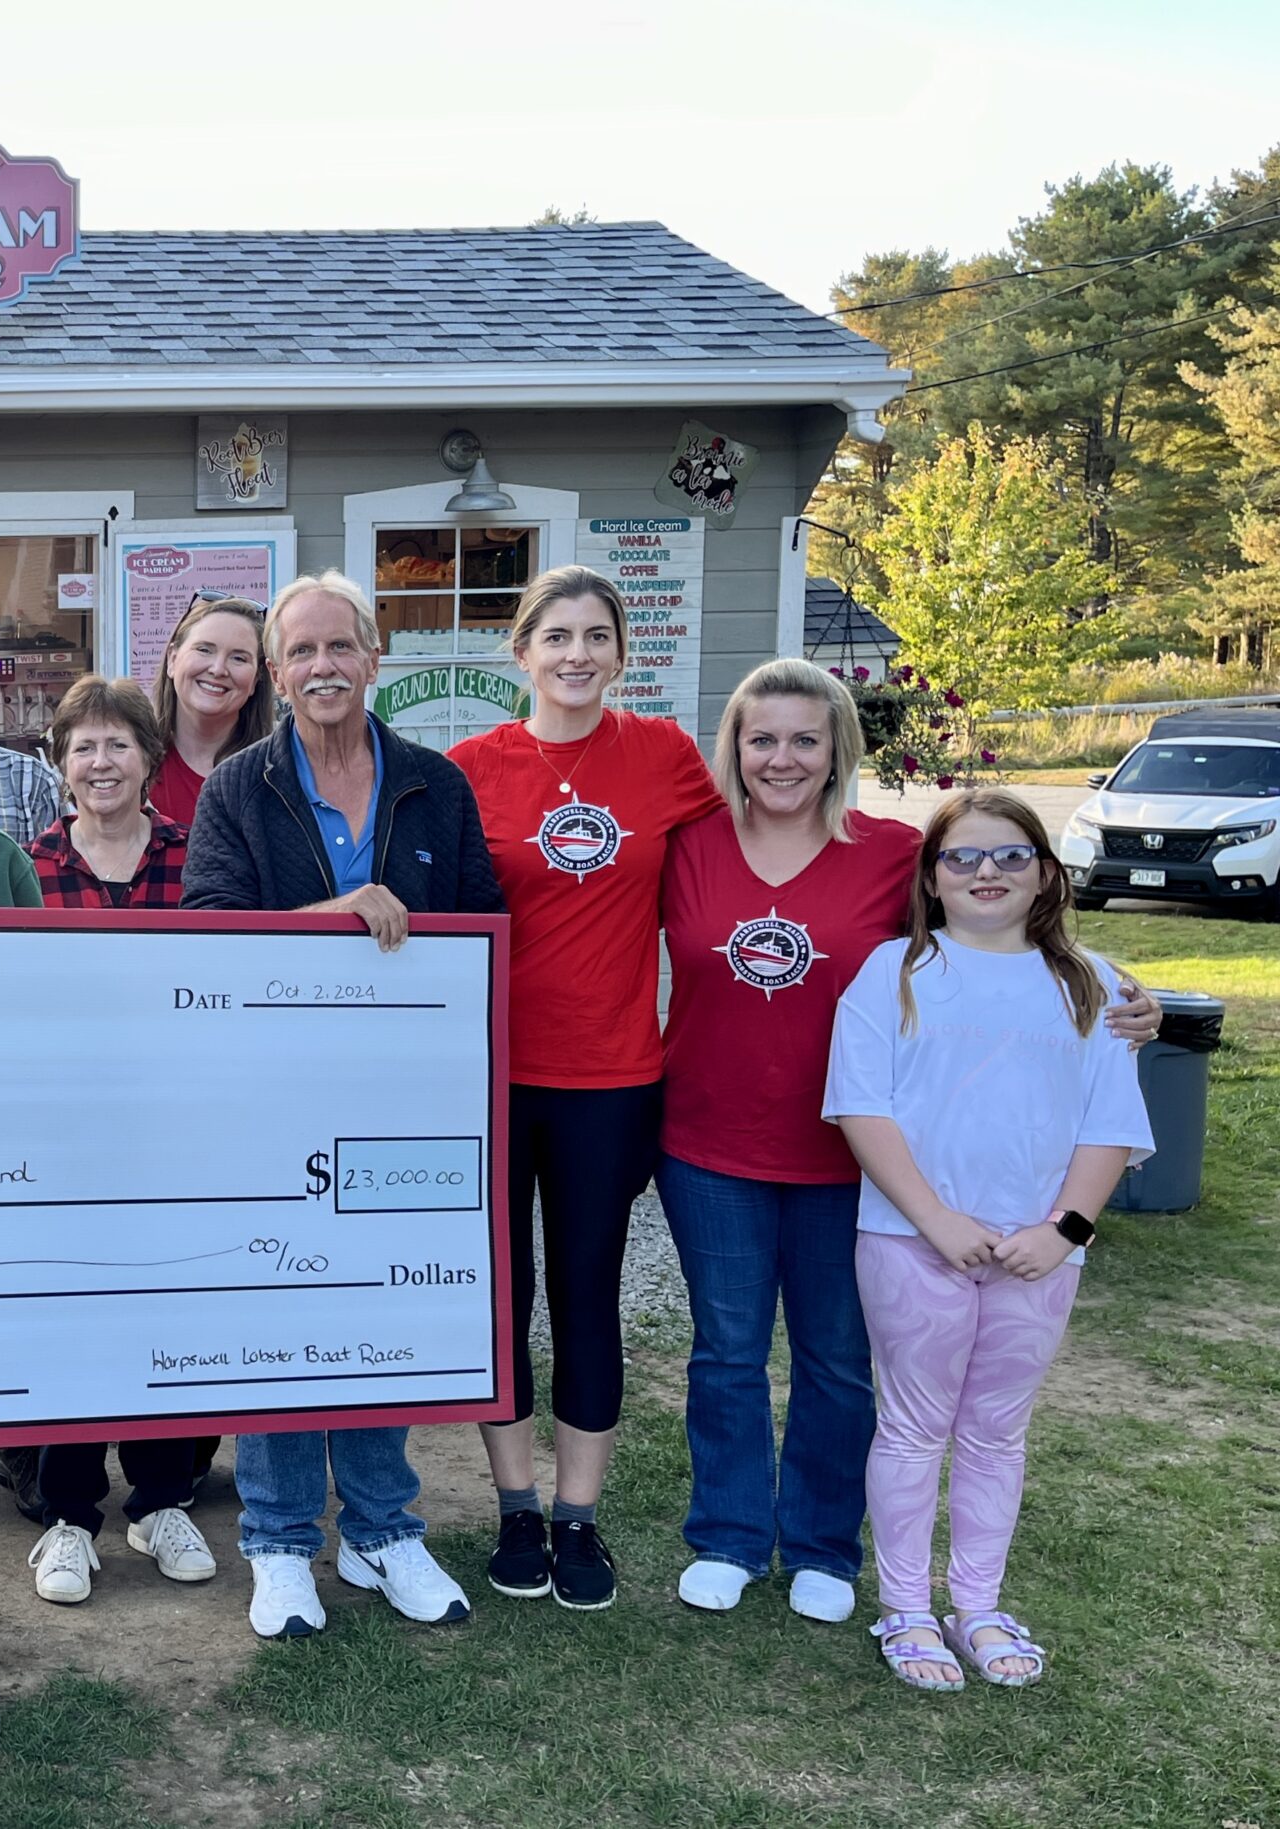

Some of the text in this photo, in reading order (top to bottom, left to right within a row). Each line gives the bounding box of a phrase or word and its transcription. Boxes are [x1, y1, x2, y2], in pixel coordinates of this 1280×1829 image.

[202, 427, 286, 472] Root Beer
[226, 462, 276, 500] Float
[600, 519, 681, 532] Hard Ice Cream
[618, 535, 662, 546] VANILLA
[133, 558, 183, 567] ICE CREAM
[608, 550, 670, 561] CHOCOLATE
[620, 565, 658, 576] COFFEE
[627, 580, 685, 592] RASPBERRY
[658, 596, 683, 607] CHIP
[652, 611, 672, 622] JOY
[629, 625, 687, 637] HEATH BAR
[639, 640, 677, 651] DOUGH
[635, 656, 673, 667] TRACKS
[391, 672, 430, 712] ROUND
[458, 669, 476, 696] ICE
[478, 672, 513, 711] CREAM
[635, 702, 673, 713] SORBET
[544, 807, 612, 833] HARPSWELL, MAINE
[545, 840, 615, 869] LOBSTER BOAT RACES
[735, 921, 806, 946] HARPSWELL, MAINE
[732, 956, 761, 983] LOBSTER
[785, 960, 805, 978] RACES
[335, 984, 376, 1001] 2024
[925, 1024, 1080, 1055] MOVE STUDIO
[305, 1149, 332, 1201] $
[342, 1168, 465, 1192] 23,000.00
[389, 1263, 477, 1287] Dollars
[152, 1347, 231, 1374] Harpswell
[242, 1346, 296, 1365] Lobster
[359, 1343, 415, 1366] Races
